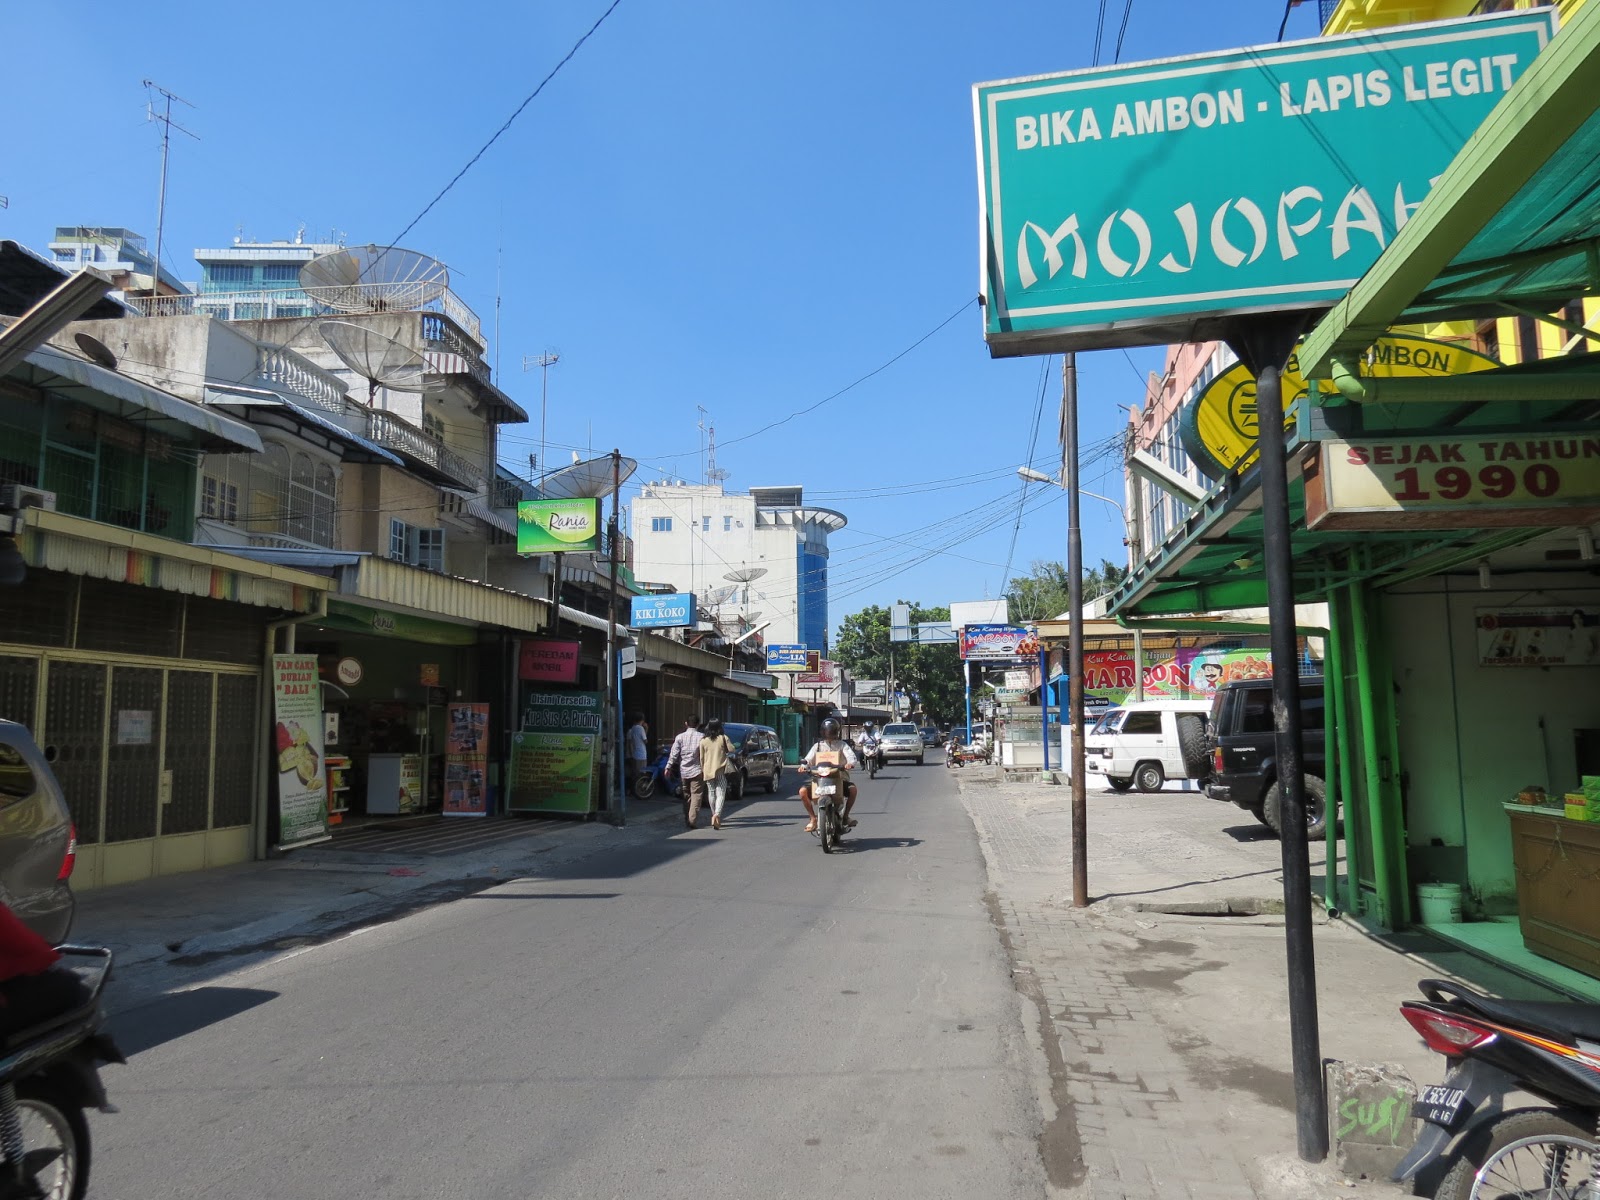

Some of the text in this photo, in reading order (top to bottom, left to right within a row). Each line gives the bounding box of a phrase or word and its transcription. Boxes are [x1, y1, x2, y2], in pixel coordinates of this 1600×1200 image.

[1015, 107, 1101, 151] BIKA
[1110, 89, 1244, 139] AMBON
[1280, 70, 1392, 118] LAPIS
[1404, 53, 1517, 103] LEGIT
[1017, 173, 1444, 290] MOJOPAH
[1361, 344, 1450, 373] MBON
[1346, 440, 1600, 466] SEJAK TAHUN
[1394, 463, 1561, 501] 1990
[549, 512, 590, 531] Rania
[635, 606, 686, 619] KIKI KOKO
[966, 633, 1018, 645] MAROON
[525, 650, 575, 660] PEREDAM
[1145, 651, 1173, 662] Hijau
[276, 661, 293, 670] PAN
[280, 672, 313, 682] DURIAN
[530, 694, 556, 705] Disini
[524, 709, 602, 731] Kue Sus & Puding
